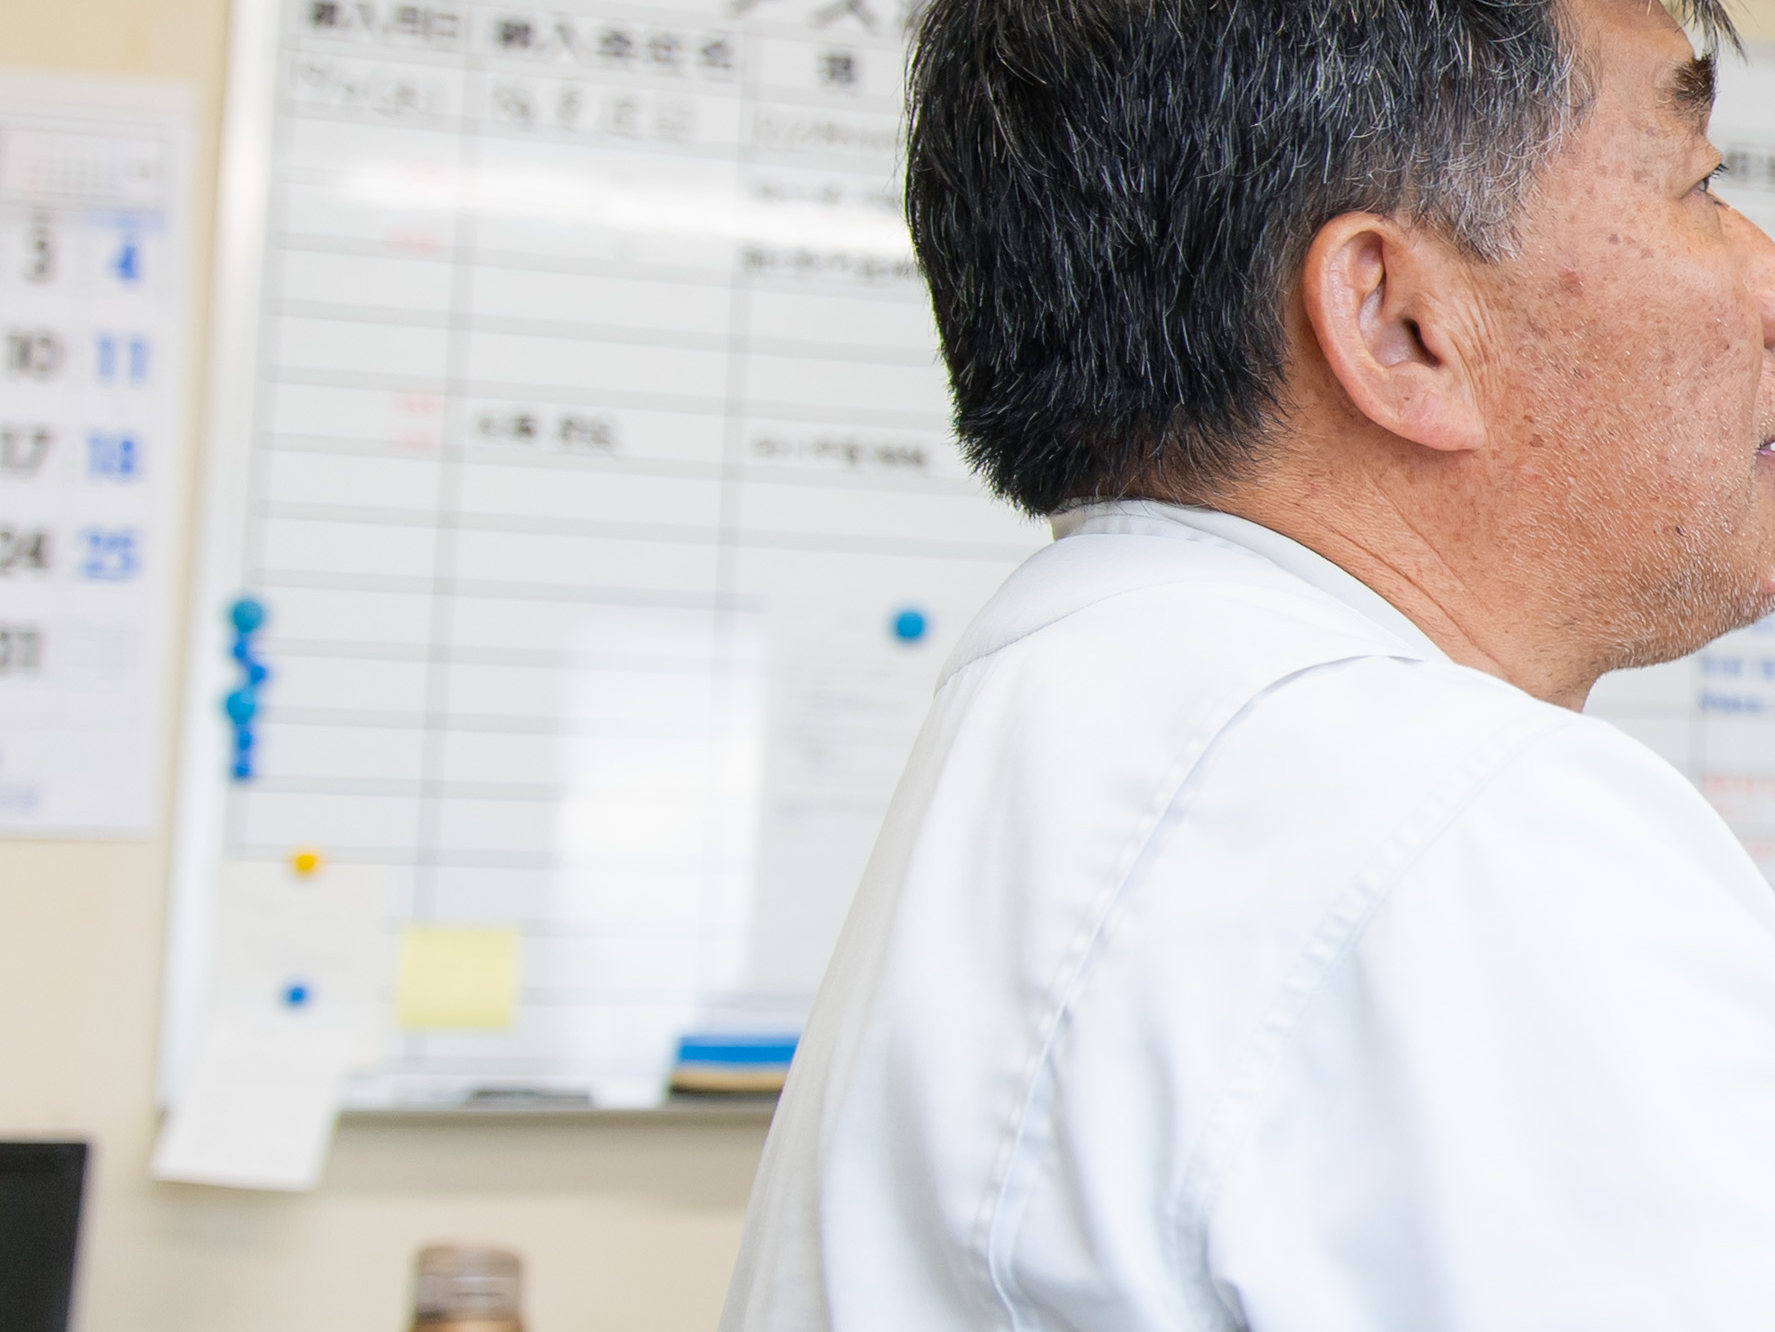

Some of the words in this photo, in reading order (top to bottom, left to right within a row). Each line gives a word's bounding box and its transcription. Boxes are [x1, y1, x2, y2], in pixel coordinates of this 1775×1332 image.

[111, 239, 140, 282] 4
[6, 332, 64, 378] 10
[96, 333, 150, 380] 11
[87, 432, 138, 479] 18
[80, 529, 138, 581] 25
